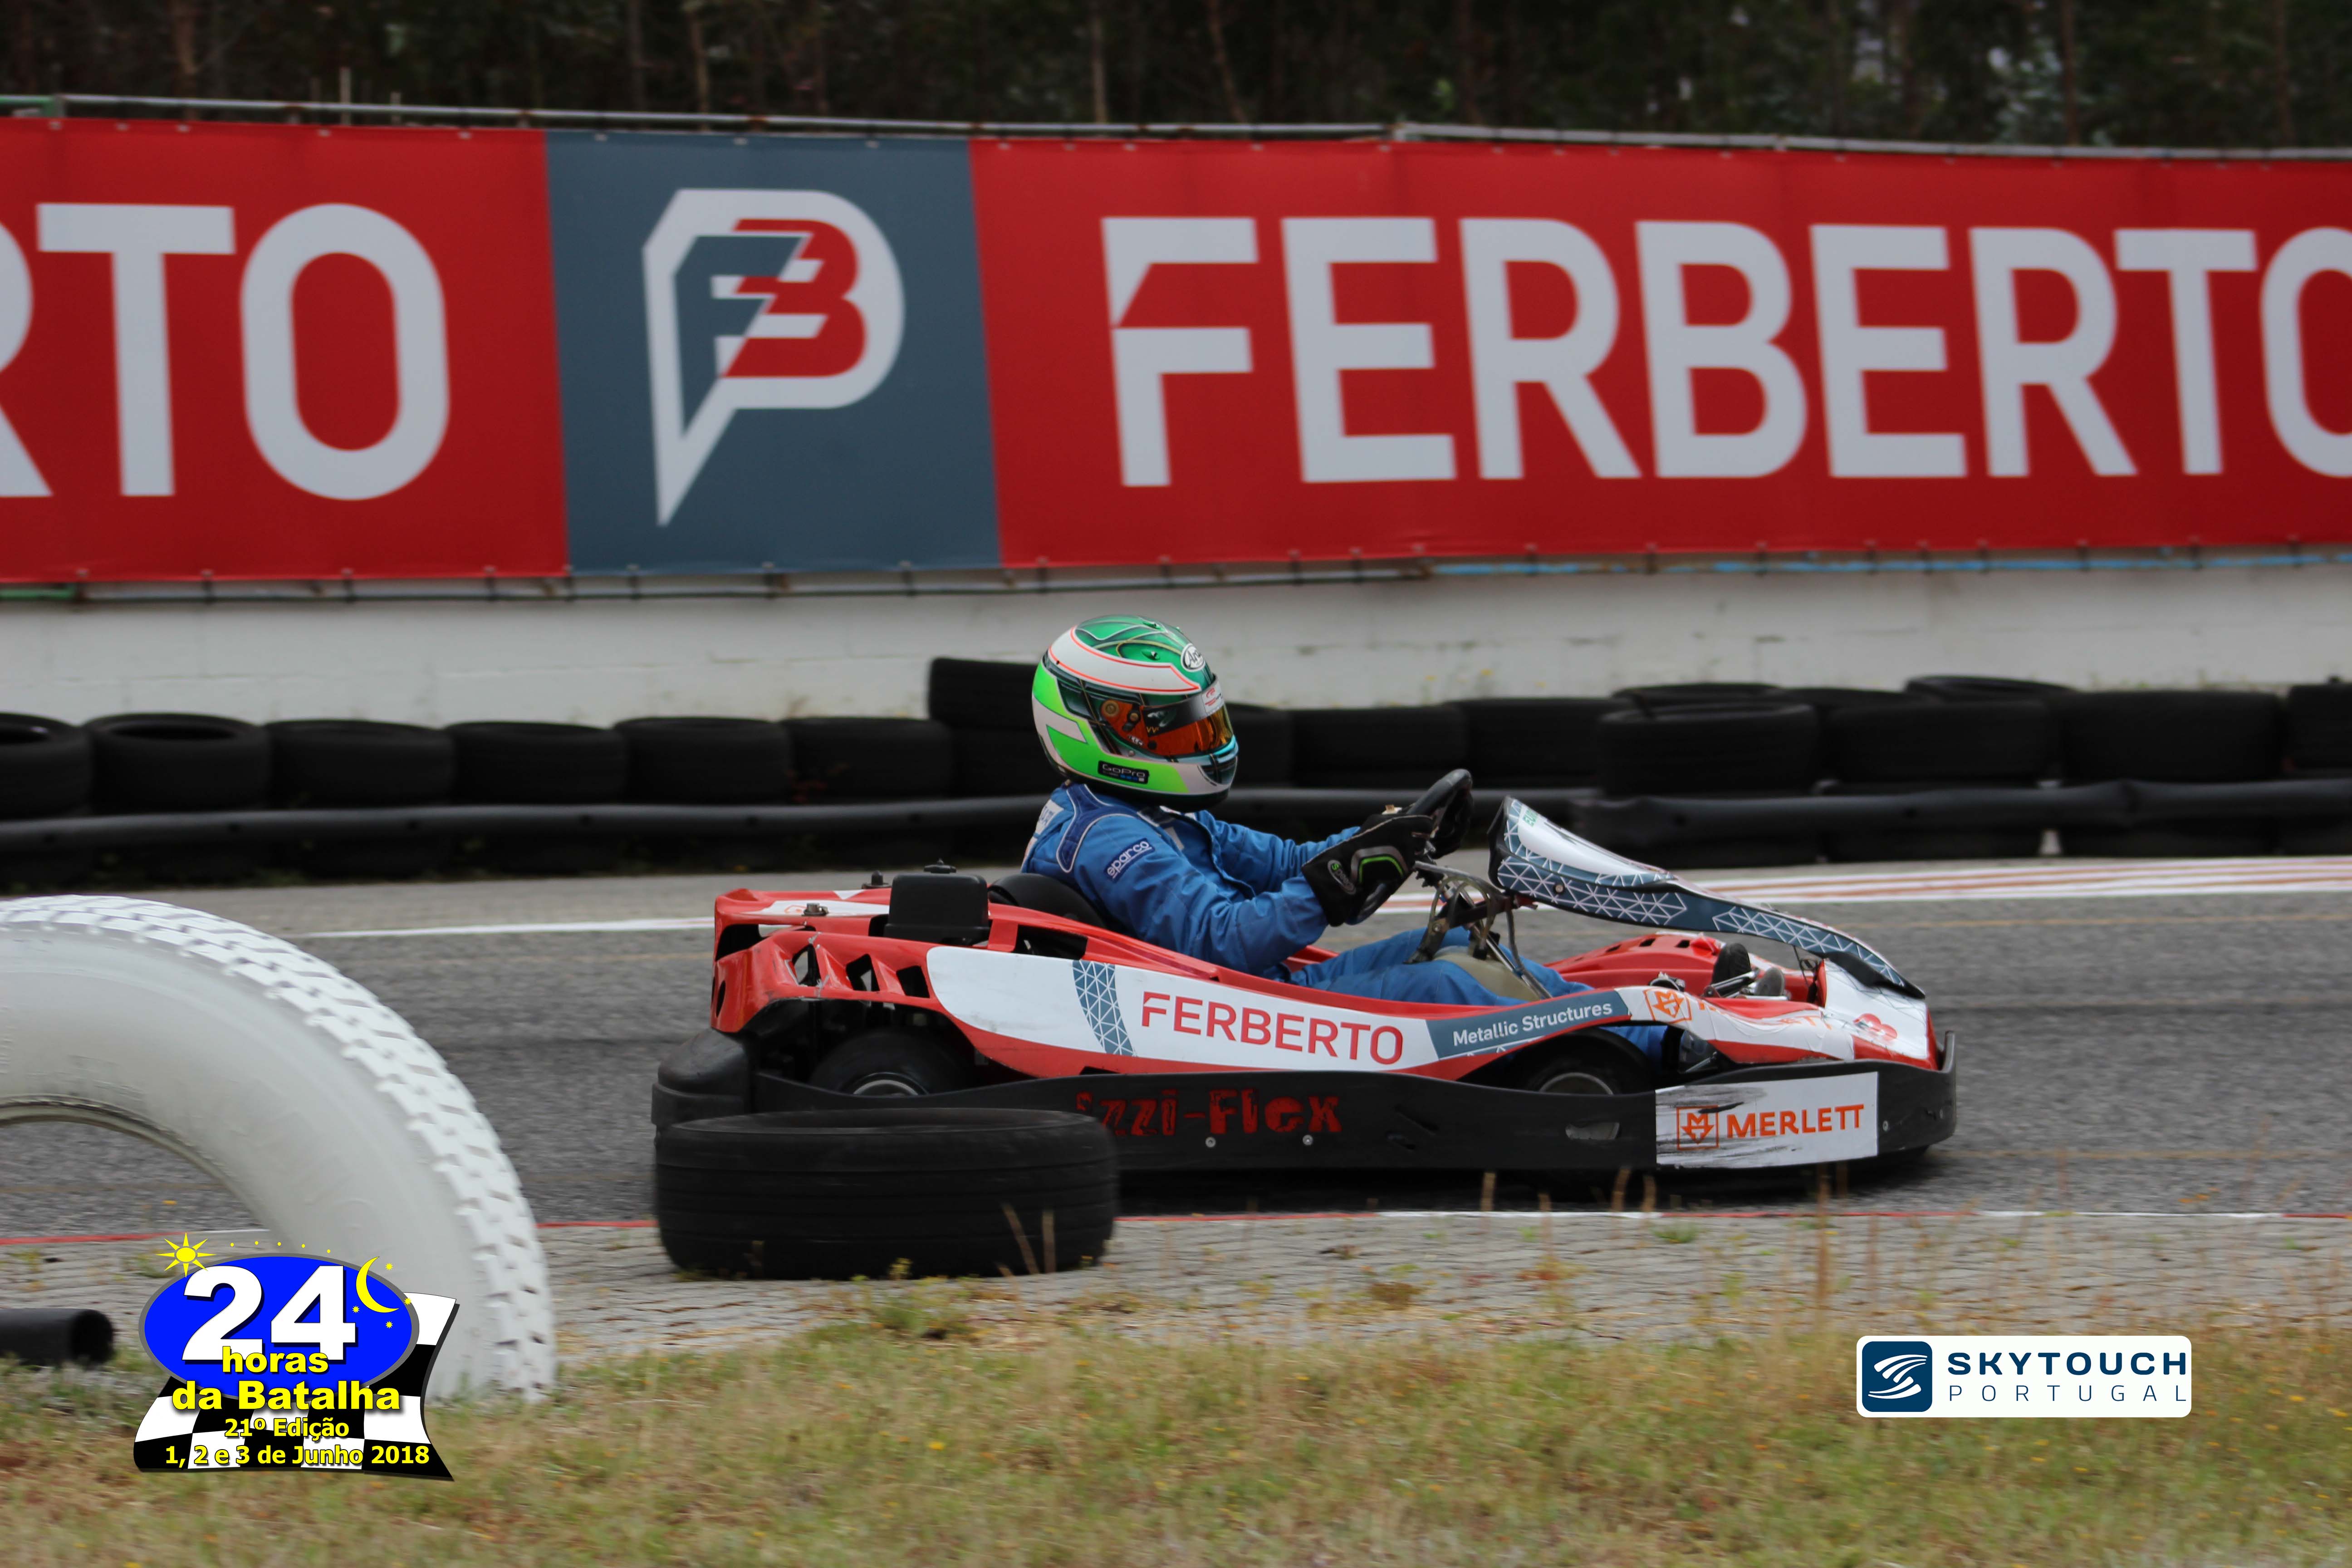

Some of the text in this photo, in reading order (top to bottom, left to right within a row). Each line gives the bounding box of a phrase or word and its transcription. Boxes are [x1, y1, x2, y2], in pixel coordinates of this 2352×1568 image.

[0, 202, 450, 500] TO
[1102, 217, 2352, 487] FERBERTO
[1102, 764, 1145, 778] GoPro
[1142, 991, 1403, 1065] FERBERTO
[1453, 1003, 1612, 1046] Metallic Structures
[1726, 1103, 1864, 1138] MERLETT
